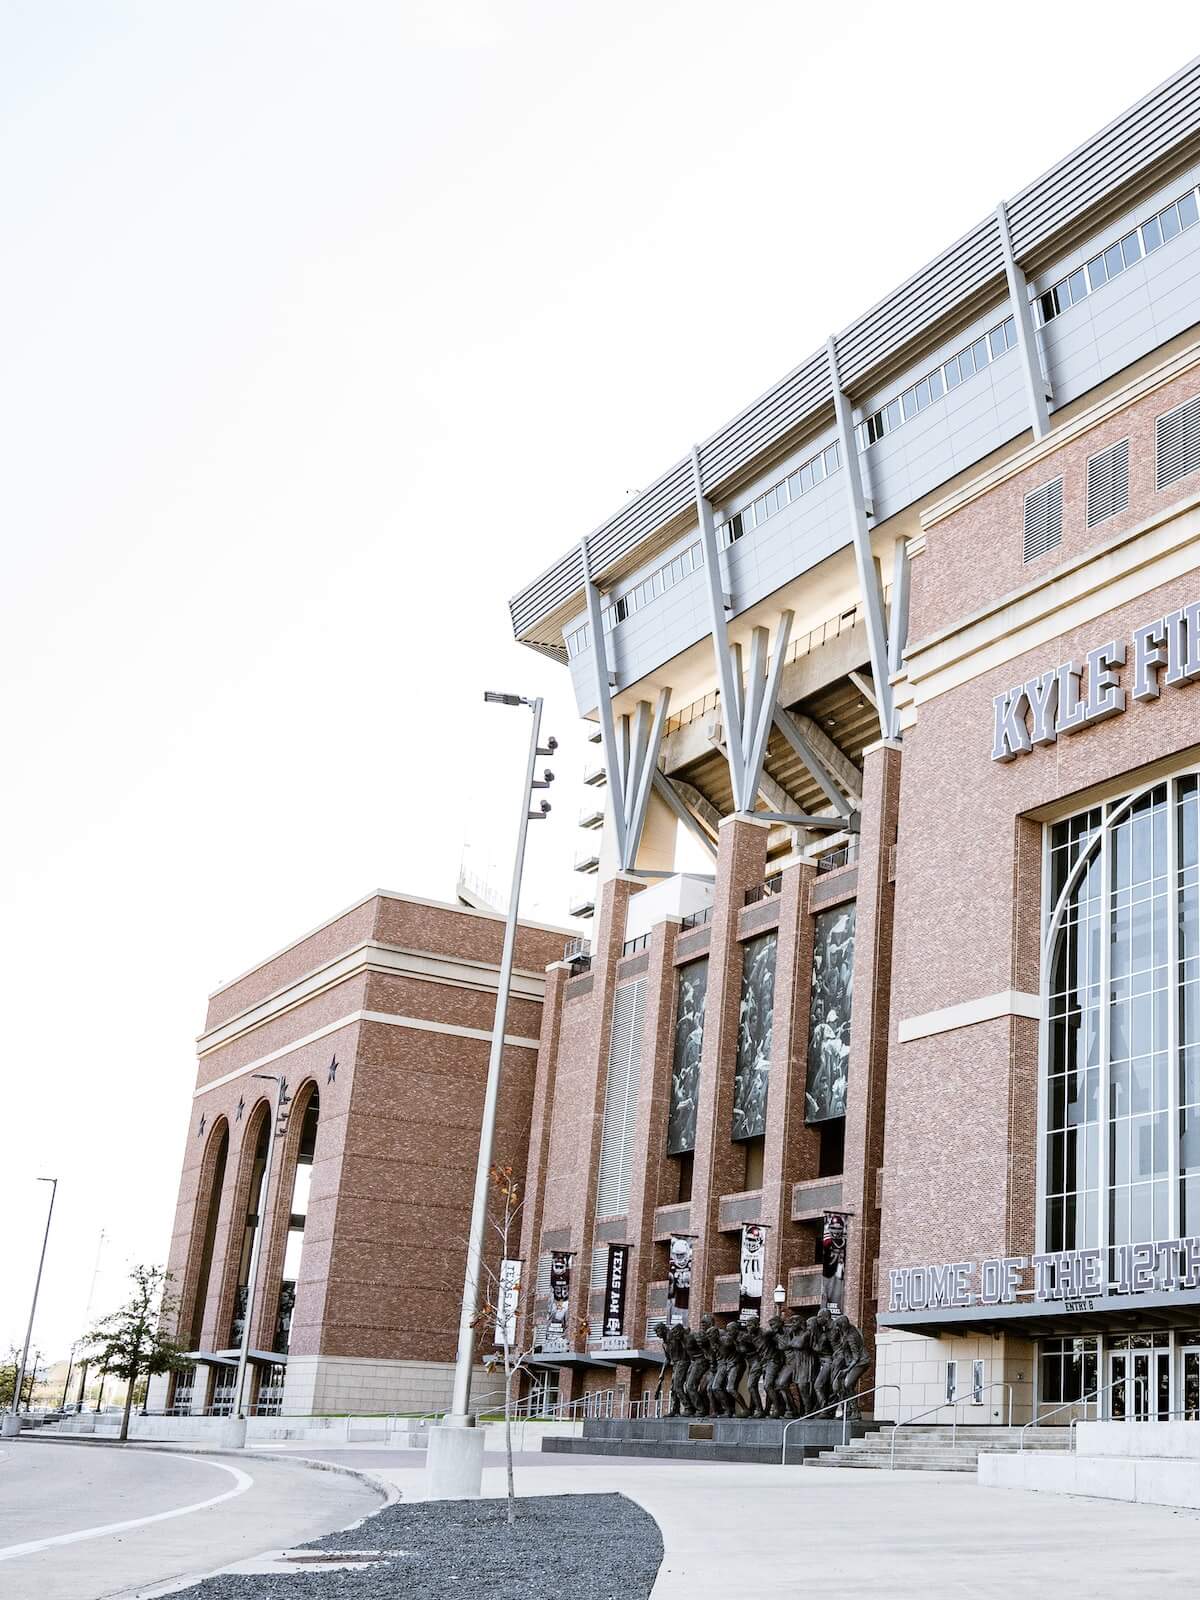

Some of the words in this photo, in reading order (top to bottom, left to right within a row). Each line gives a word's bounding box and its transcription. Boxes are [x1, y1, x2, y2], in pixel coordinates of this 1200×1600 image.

[991, 639, 1126, 764] KYLE
[611, 1250, 623, 1289] TEXAS
[889, 1262, 975, 1312] HOME
[981, 1256, 1029, 1304] OF
[1032, 1247, 1104, 1300] THE
[1065, 1301, 1087, 1312] ENTRY
